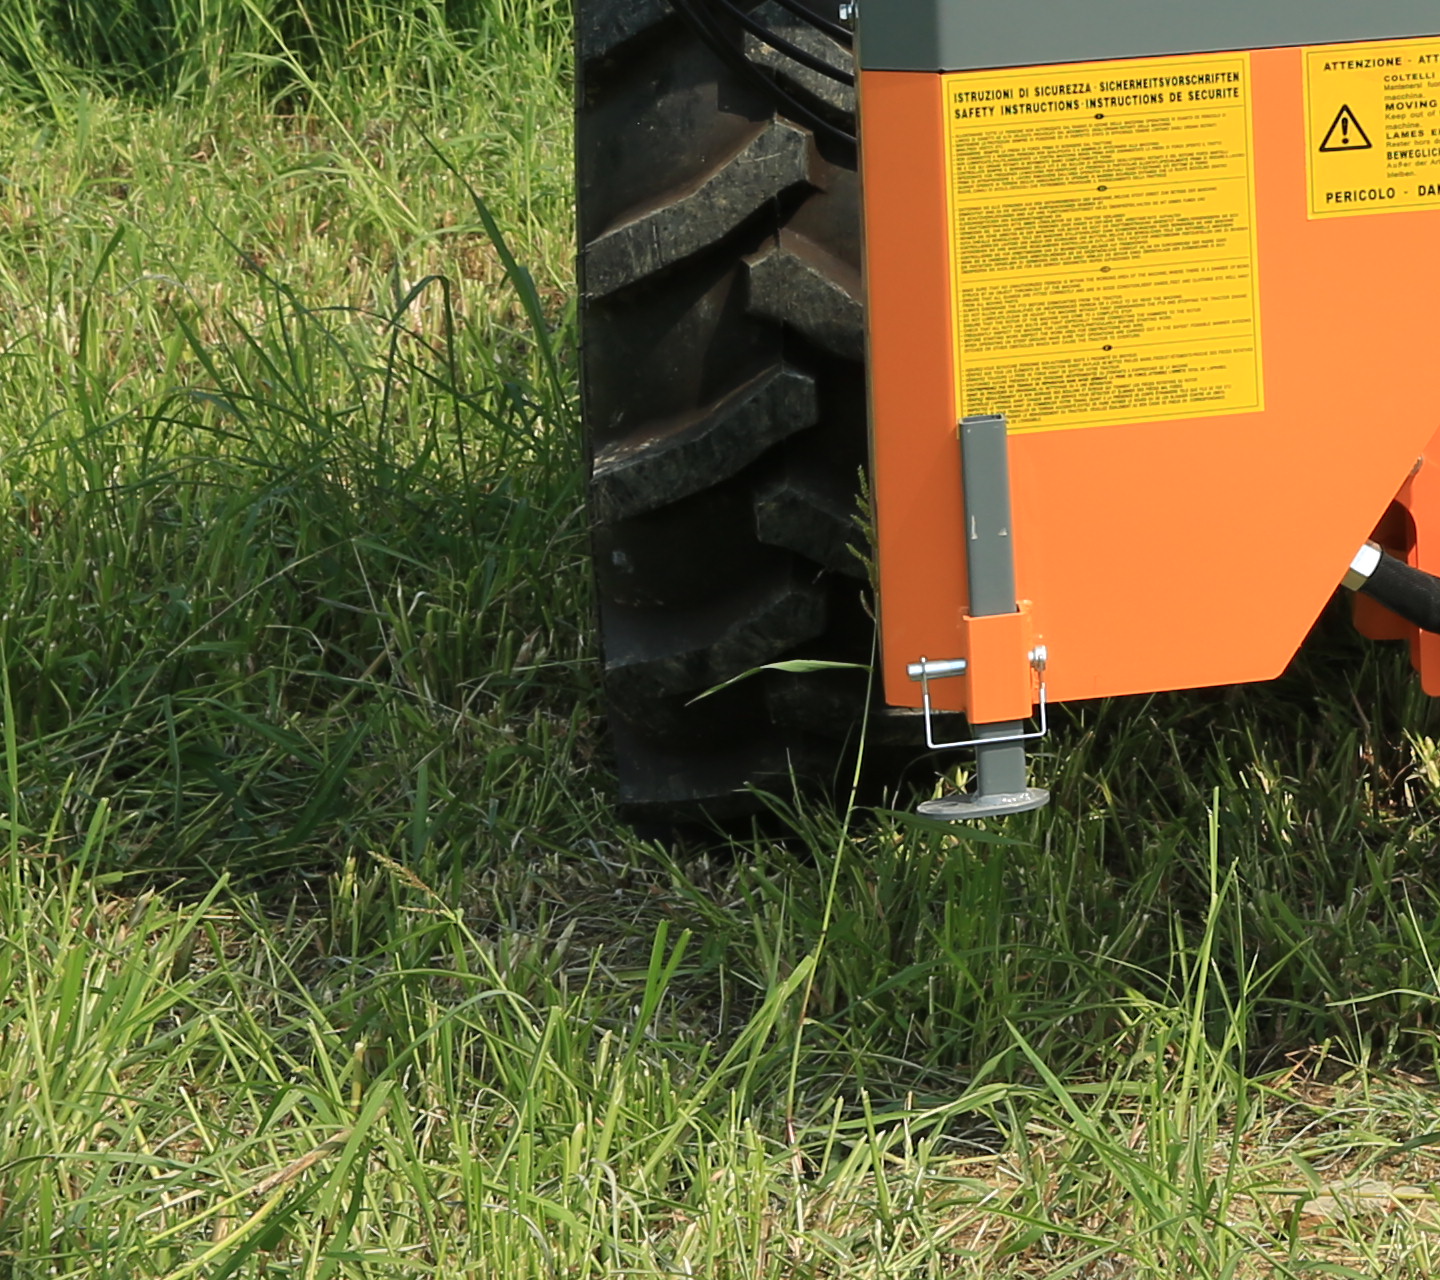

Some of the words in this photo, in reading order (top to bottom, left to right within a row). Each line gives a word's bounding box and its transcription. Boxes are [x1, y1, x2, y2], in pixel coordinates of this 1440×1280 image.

[1323, 57, 1402, 71] ATTENZIONE
[1383, 71, 1435, 82] COLTELLI
[954, 88, 1013, 104] ISTRUZIONI
[1019, 87, 1029, 98] DI
[1034, 83, 1092, 97] SICUREZZA
[1099, 71, 1240, 92] SICHERHEITSVORSCHRIFTEN
[954, 106, 995, 119] SAFETY
[1001, 99, 1080, 116] INSTRUCTIONS
[1085, 93, 1164, 109] INSTRUCTIONS
[1169, 91, 1182, 102] DE
[1188, 87, 1239, 101] SECURITE
[1385, 99, 1438, 111] MOVING
[1385, 113, 1406, 121] Keep
[1410, 111, 1423, 119] out
[1386, 130, 1424, 140] LAMES
[1326, 187, 1396, 204] PERICOLO
